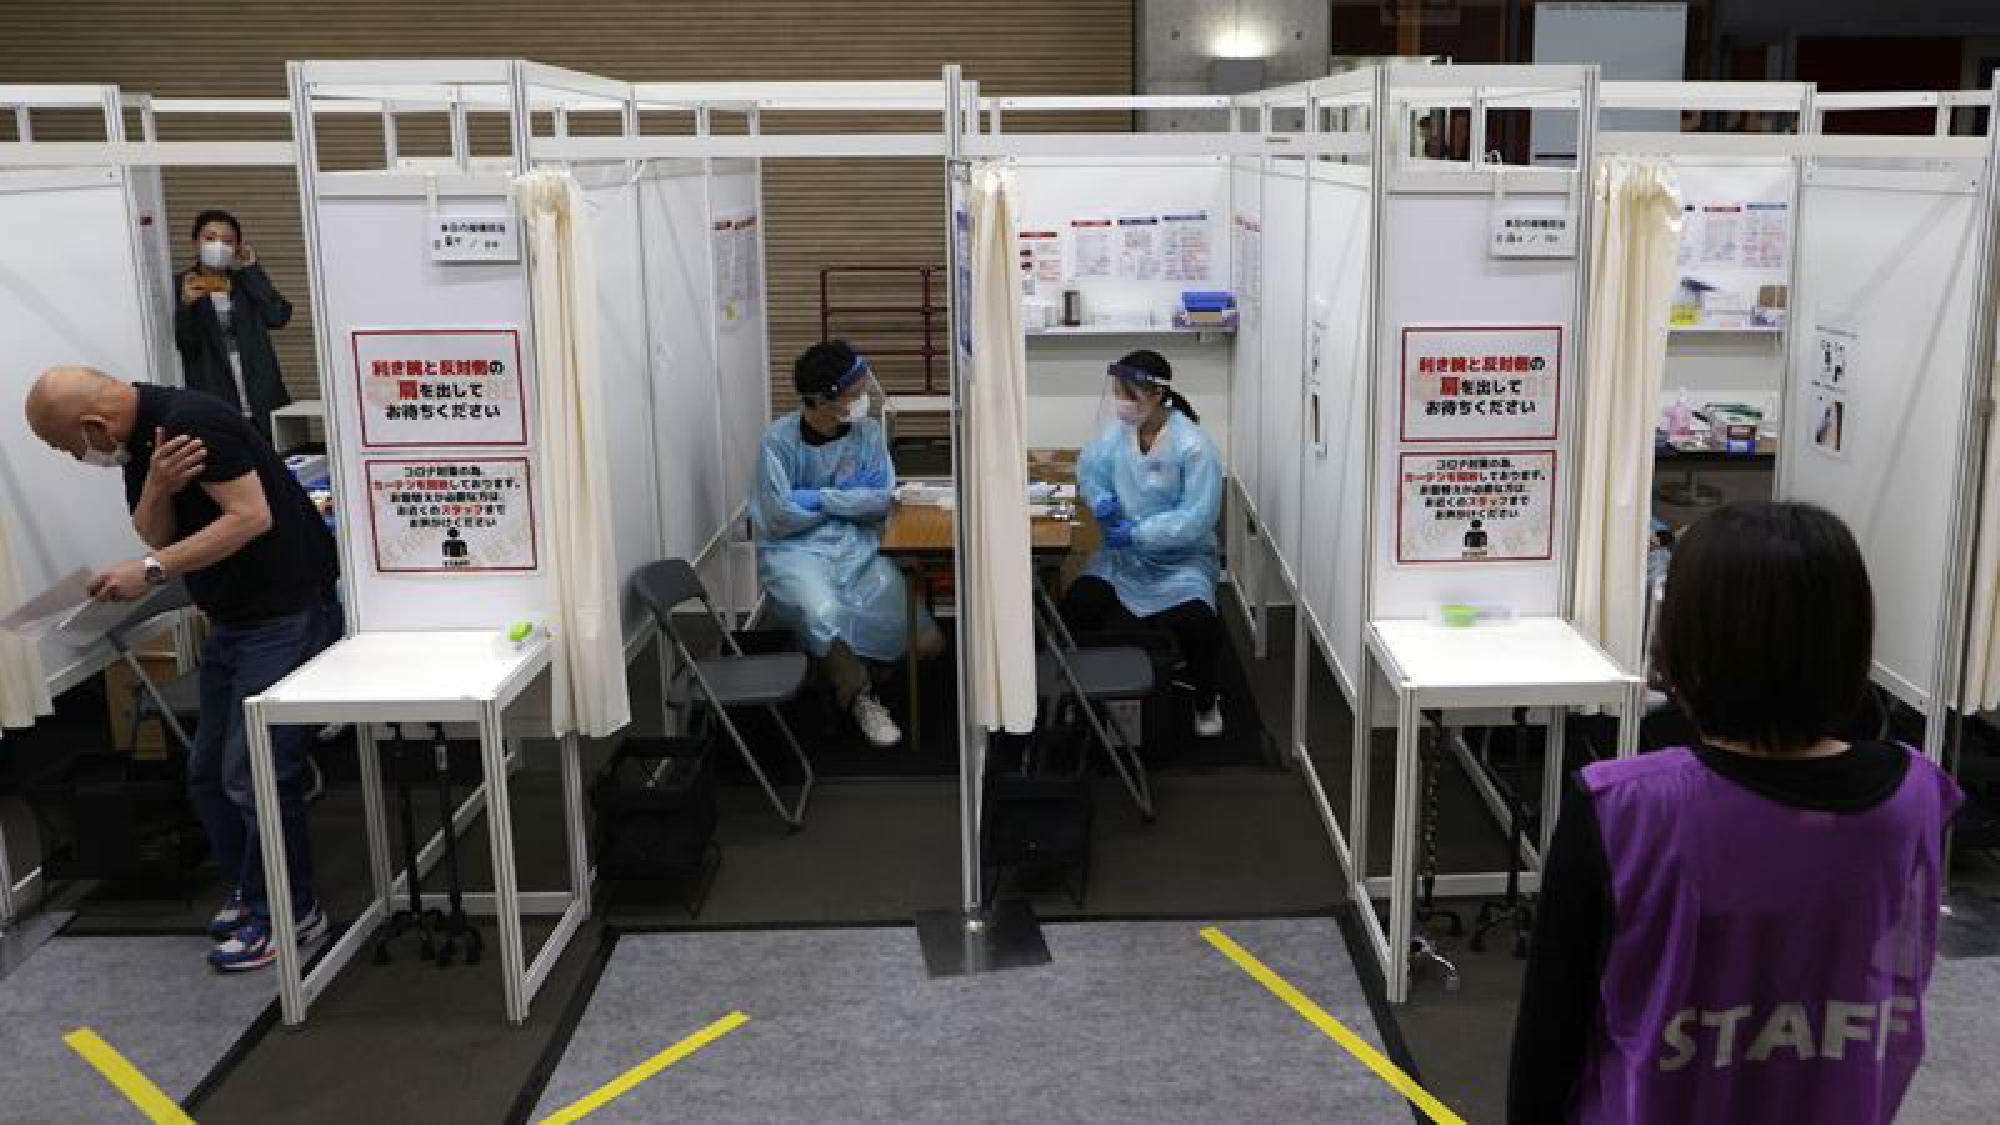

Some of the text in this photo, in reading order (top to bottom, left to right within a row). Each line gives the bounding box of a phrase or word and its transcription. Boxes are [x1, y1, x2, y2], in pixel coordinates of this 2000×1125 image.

[371, 359, 506, 377] 利き腕と反対側の
[1419, 356, 1546, 373] 利き腕と反対側の
[399, 379, 483, 401] 肩を出して
[1440, 376, 1523, 396] 肩を出して
[385, 402, 501, 421] お待ちください
[1425, 399, 1536, 417] お待ちください
[1659, 996, 1918, 1071] STAFF
